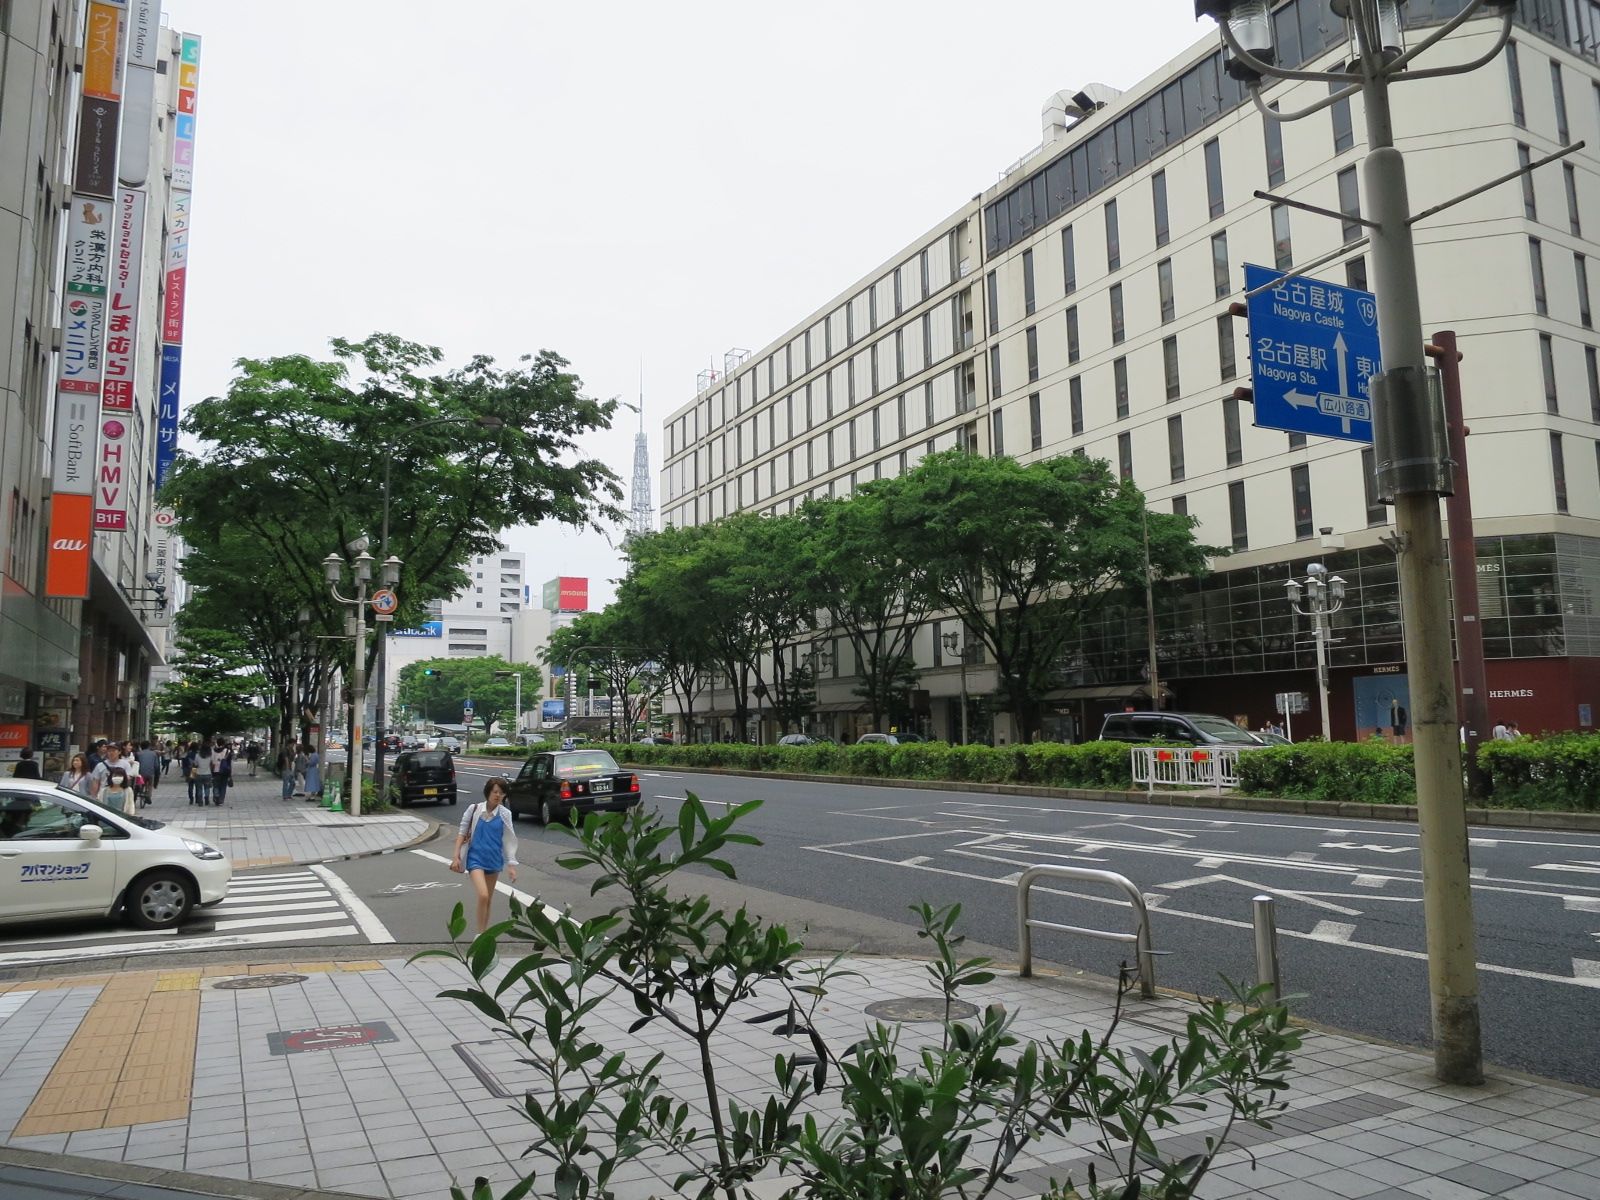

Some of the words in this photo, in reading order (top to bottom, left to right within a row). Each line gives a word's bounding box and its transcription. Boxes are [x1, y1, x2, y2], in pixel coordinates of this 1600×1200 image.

[172, 203, 185, 259] スカイル
[71, 239, 86, 282] クリニック
[86, 229, 106, 284] 栄漢方内科
[167, 273, 181, 328] レストラン街
[1272, 281, 1344, 314] 名古屋城
[1361, 302, 1374, 319] 19
[1273, 302, 1311, 322] Nagoya
[1314, 311, 1344, 329] Castle
[64, 320, 87, 375] メニコン
[106, 292, 132, 376] しまむら
[1257, 337, 1328, 371] 名古屋駅
[105, 381, 127, 392] 4F
[1258, 362, 1297, 383] Nagoya
[1300, 370, 1318, 385] Sta.
[104, 393, 127, 405] 3F
[160, 382, 176, 442] メルサ
[1323, 398, 1365, 417] 広小路通
[66, 423, 84, 482] SoftBank
[100, 443, 122, 506] HMV
[96, 513, 121, 523] B1F
[53, 538, 87, 551] au
[21, 862, 91, 876] アパマンショップ
